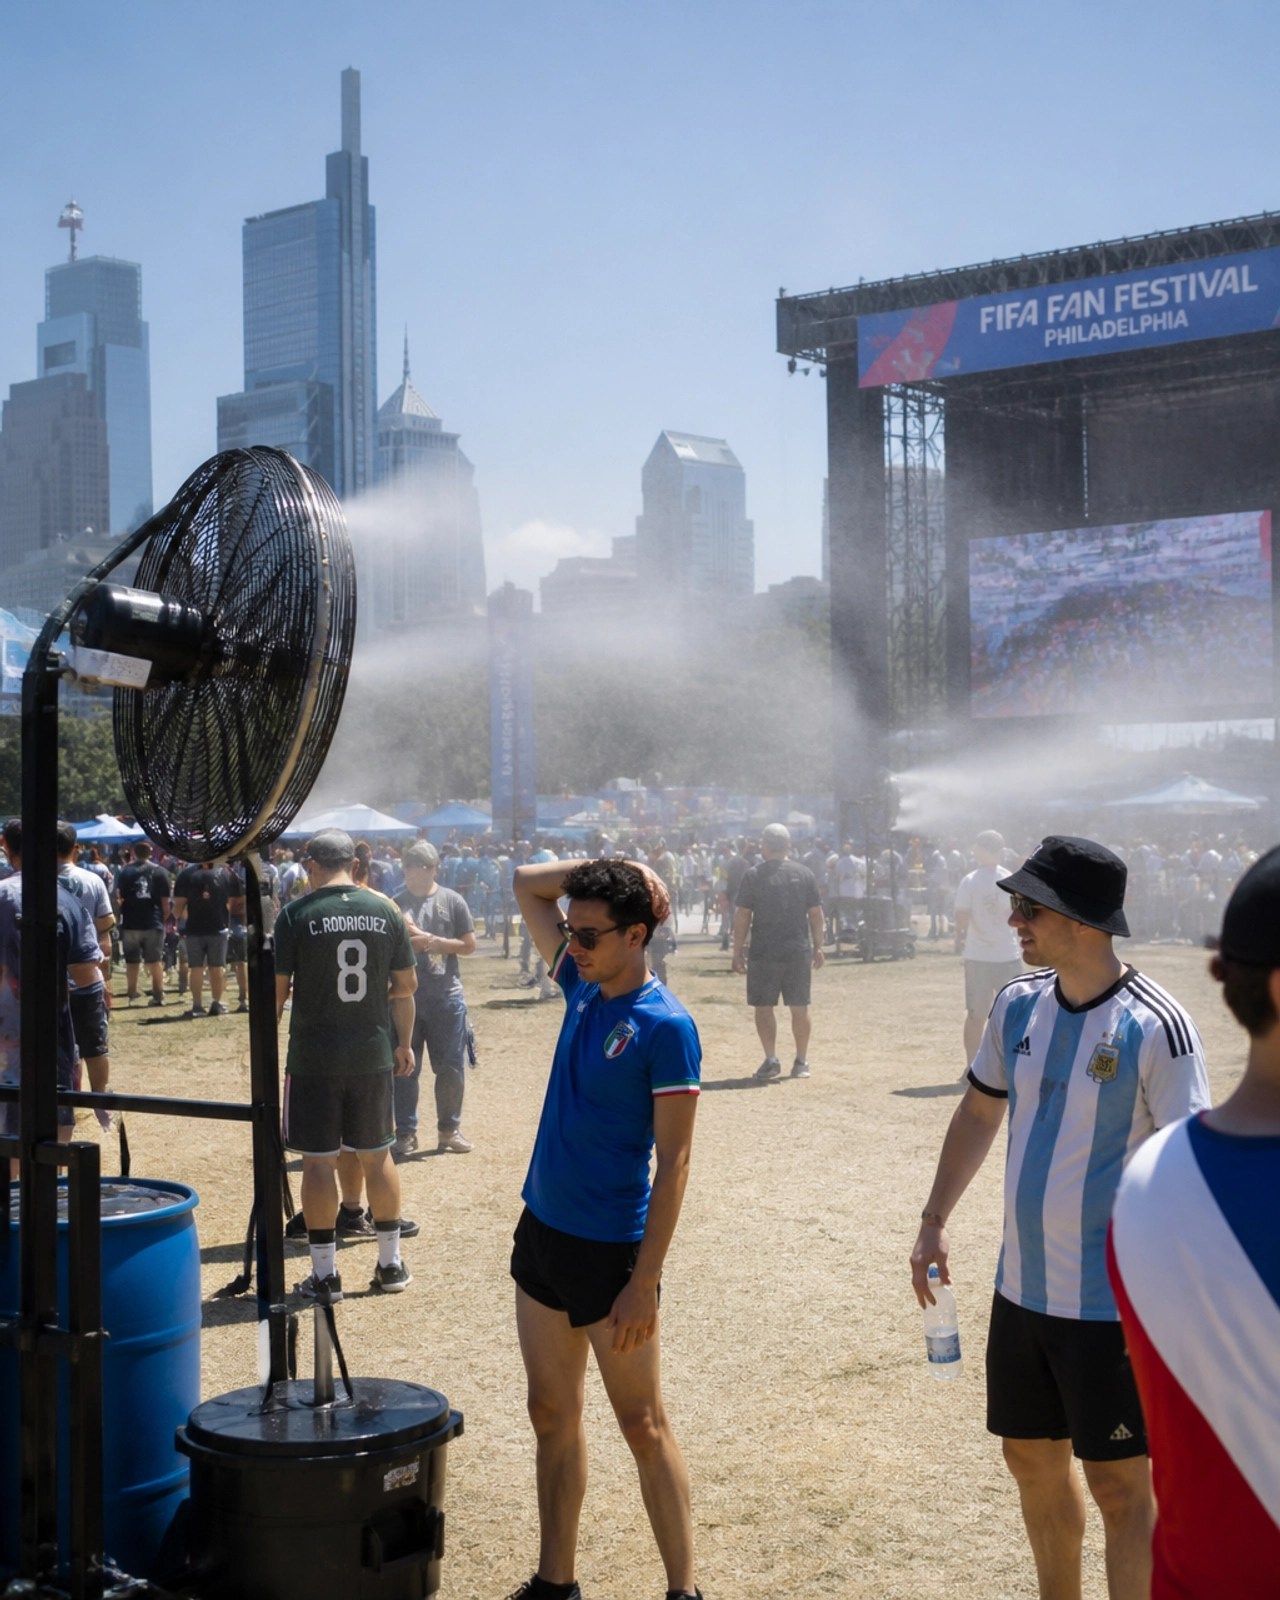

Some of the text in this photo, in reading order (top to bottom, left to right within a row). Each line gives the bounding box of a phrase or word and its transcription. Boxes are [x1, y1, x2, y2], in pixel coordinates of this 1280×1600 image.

[980, 265, 1258, 334] FIFA FAN FESTIVAL
[1045, 308, 1189, 347] PHILADELPHIA
[337, 939, 368, 1002] 8
